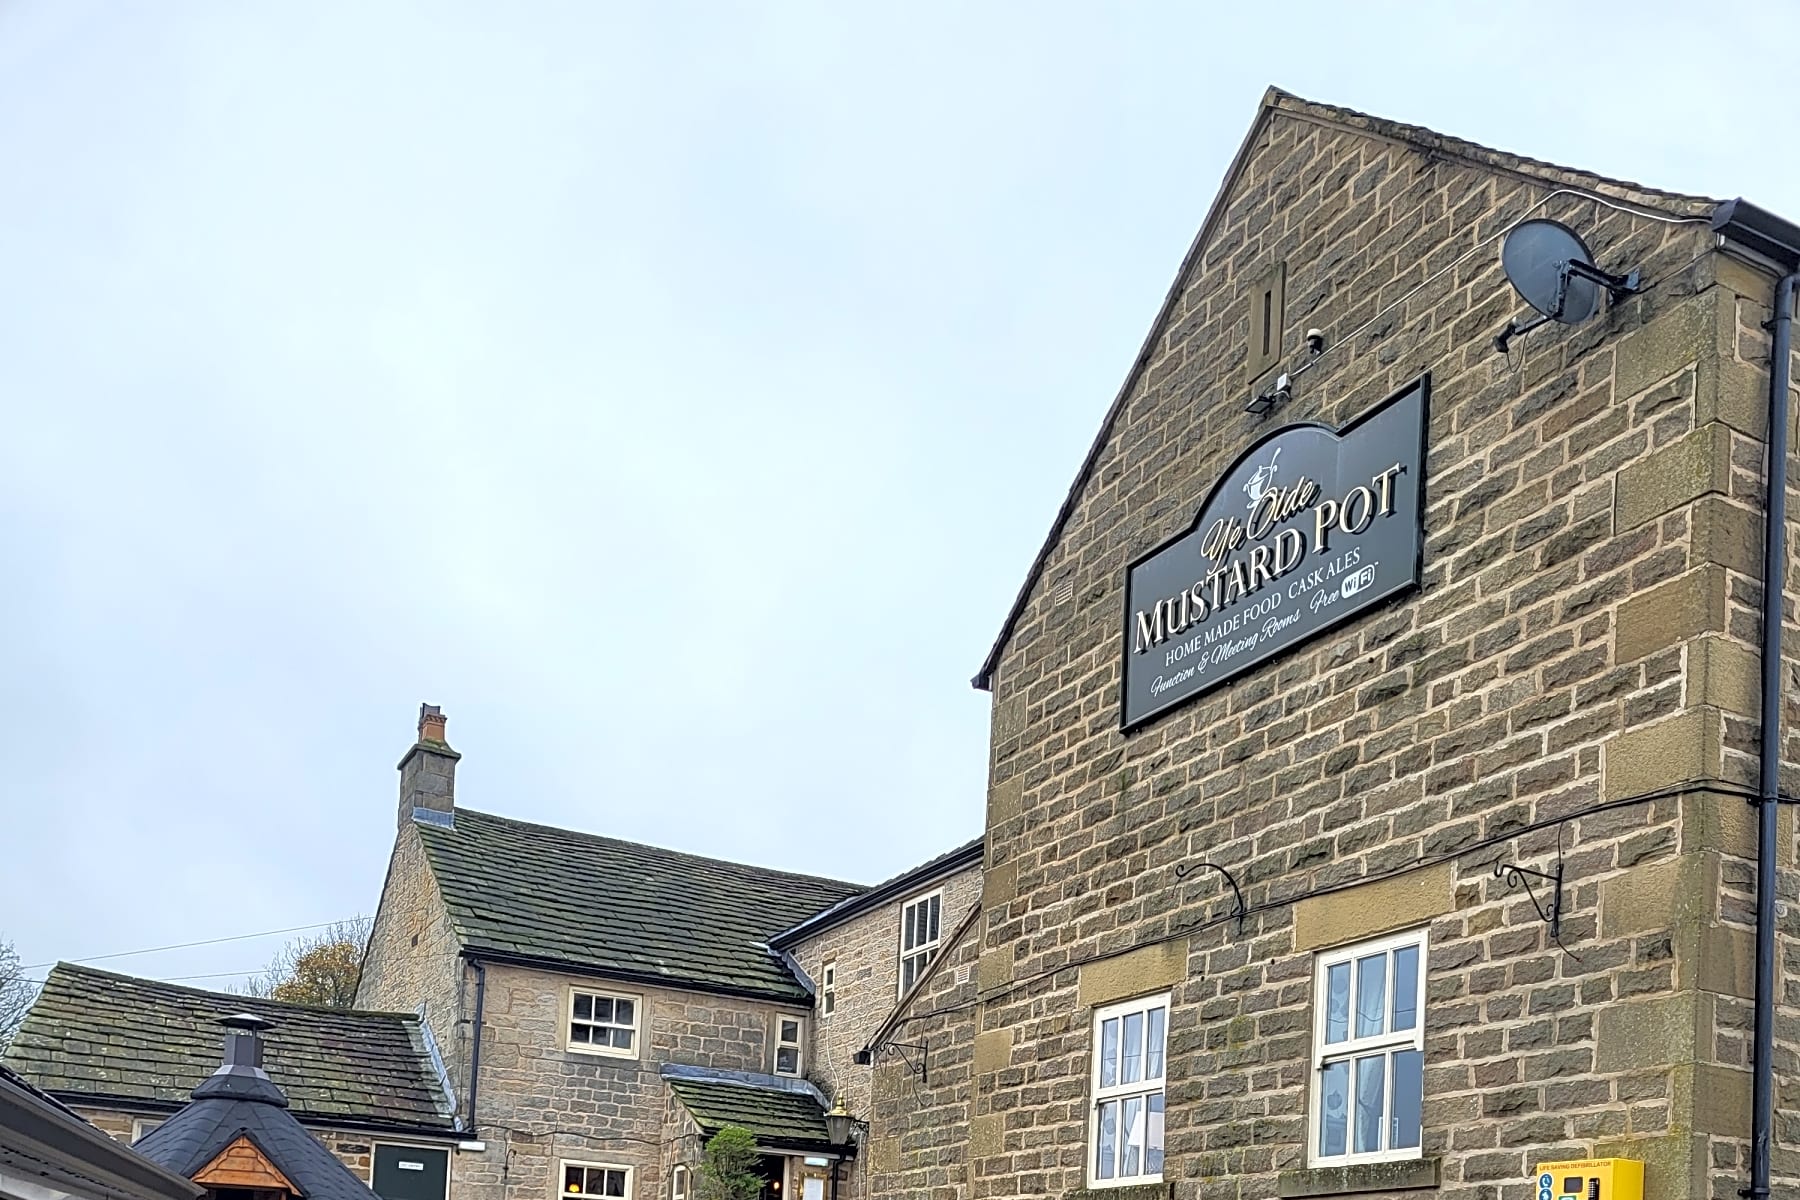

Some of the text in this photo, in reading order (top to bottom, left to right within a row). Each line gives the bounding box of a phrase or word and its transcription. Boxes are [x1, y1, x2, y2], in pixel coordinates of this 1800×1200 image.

[1133, 462, 1401, 653] MUSTARD POT
[1201, 476, 1314, 575] Ye Olde
[1150, 666, 1195, 697] Function
[1197, 651, 1210, 674] &
[1210, 633, 1259, 665] Meeting
[1259, 608, 1302, 642] Rooms
[1309, 588, 1340, 614] Free
[1165, 546, 1361, 667] HOME MADE FOOD CASK ALES
